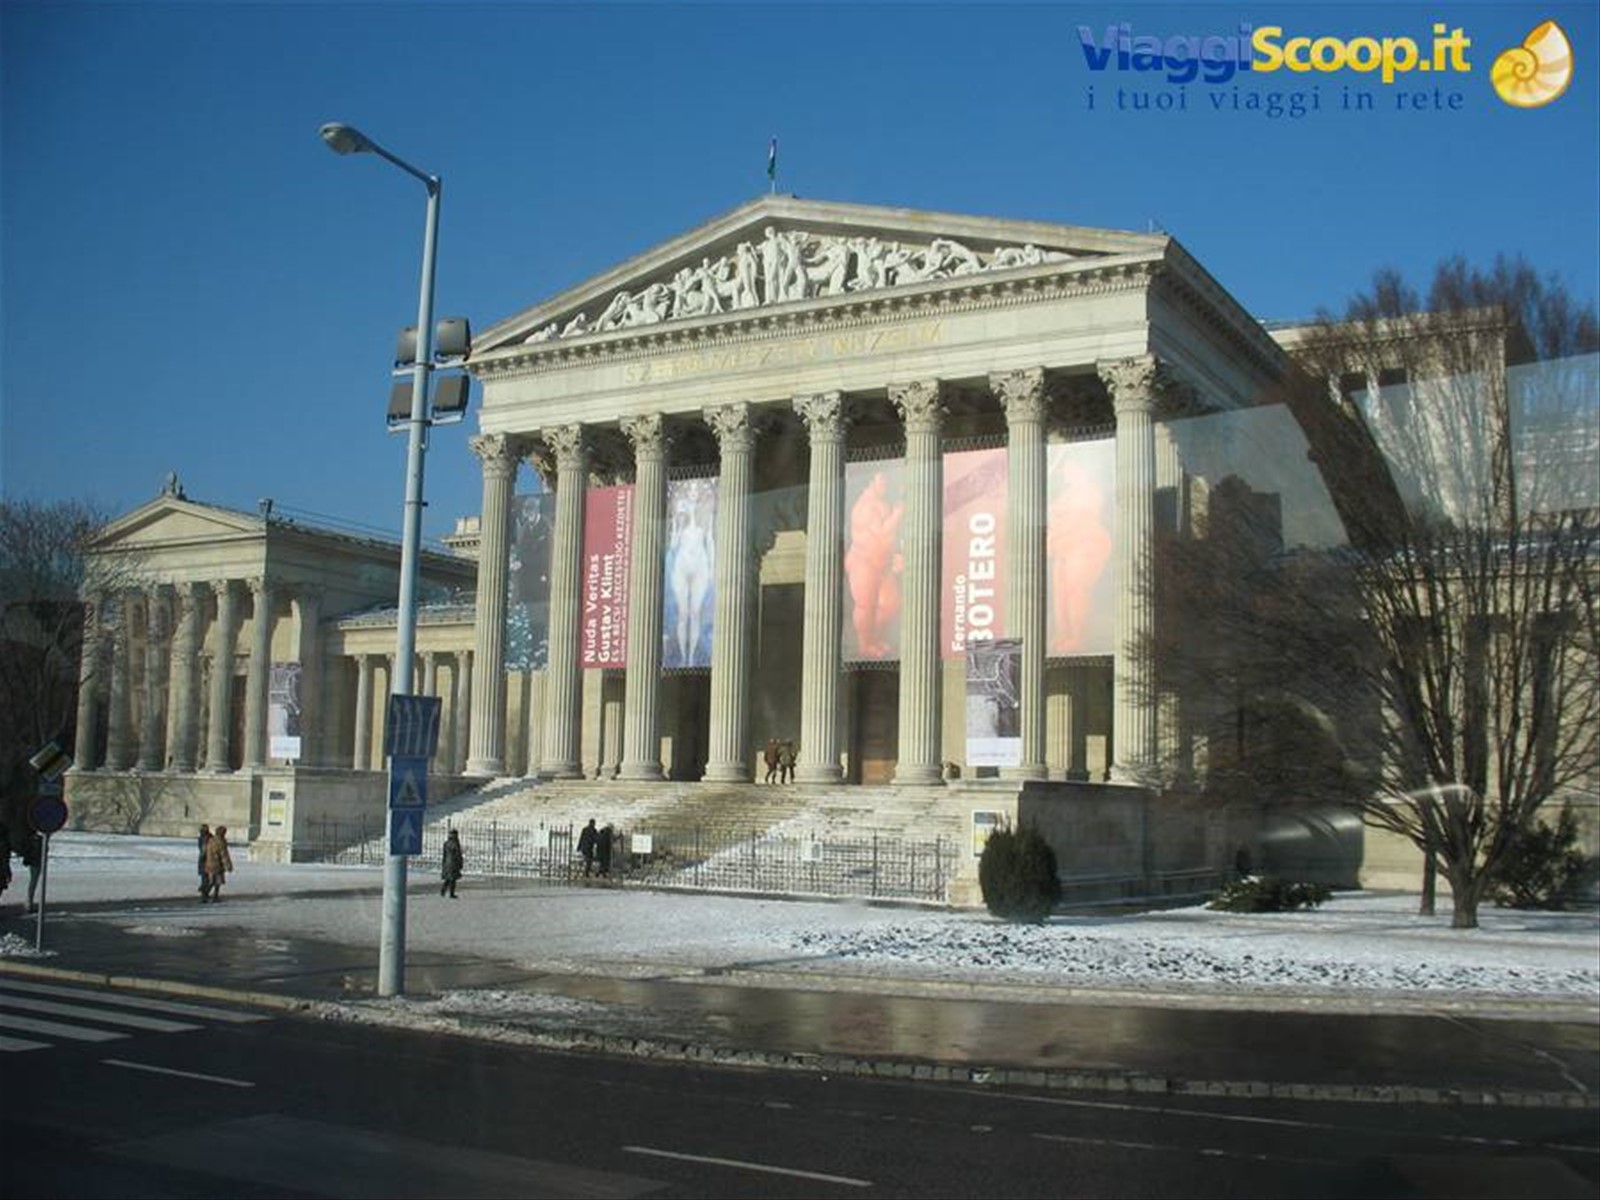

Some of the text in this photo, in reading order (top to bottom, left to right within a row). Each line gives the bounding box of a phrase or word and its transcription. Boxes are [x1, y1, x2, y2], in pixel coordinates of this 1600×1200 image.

[584, 554, 600, 662] Nuda Veritas
[598, 554, 615, 662] Gustav Klimt
[952, 574, 966, 651] Fernando
